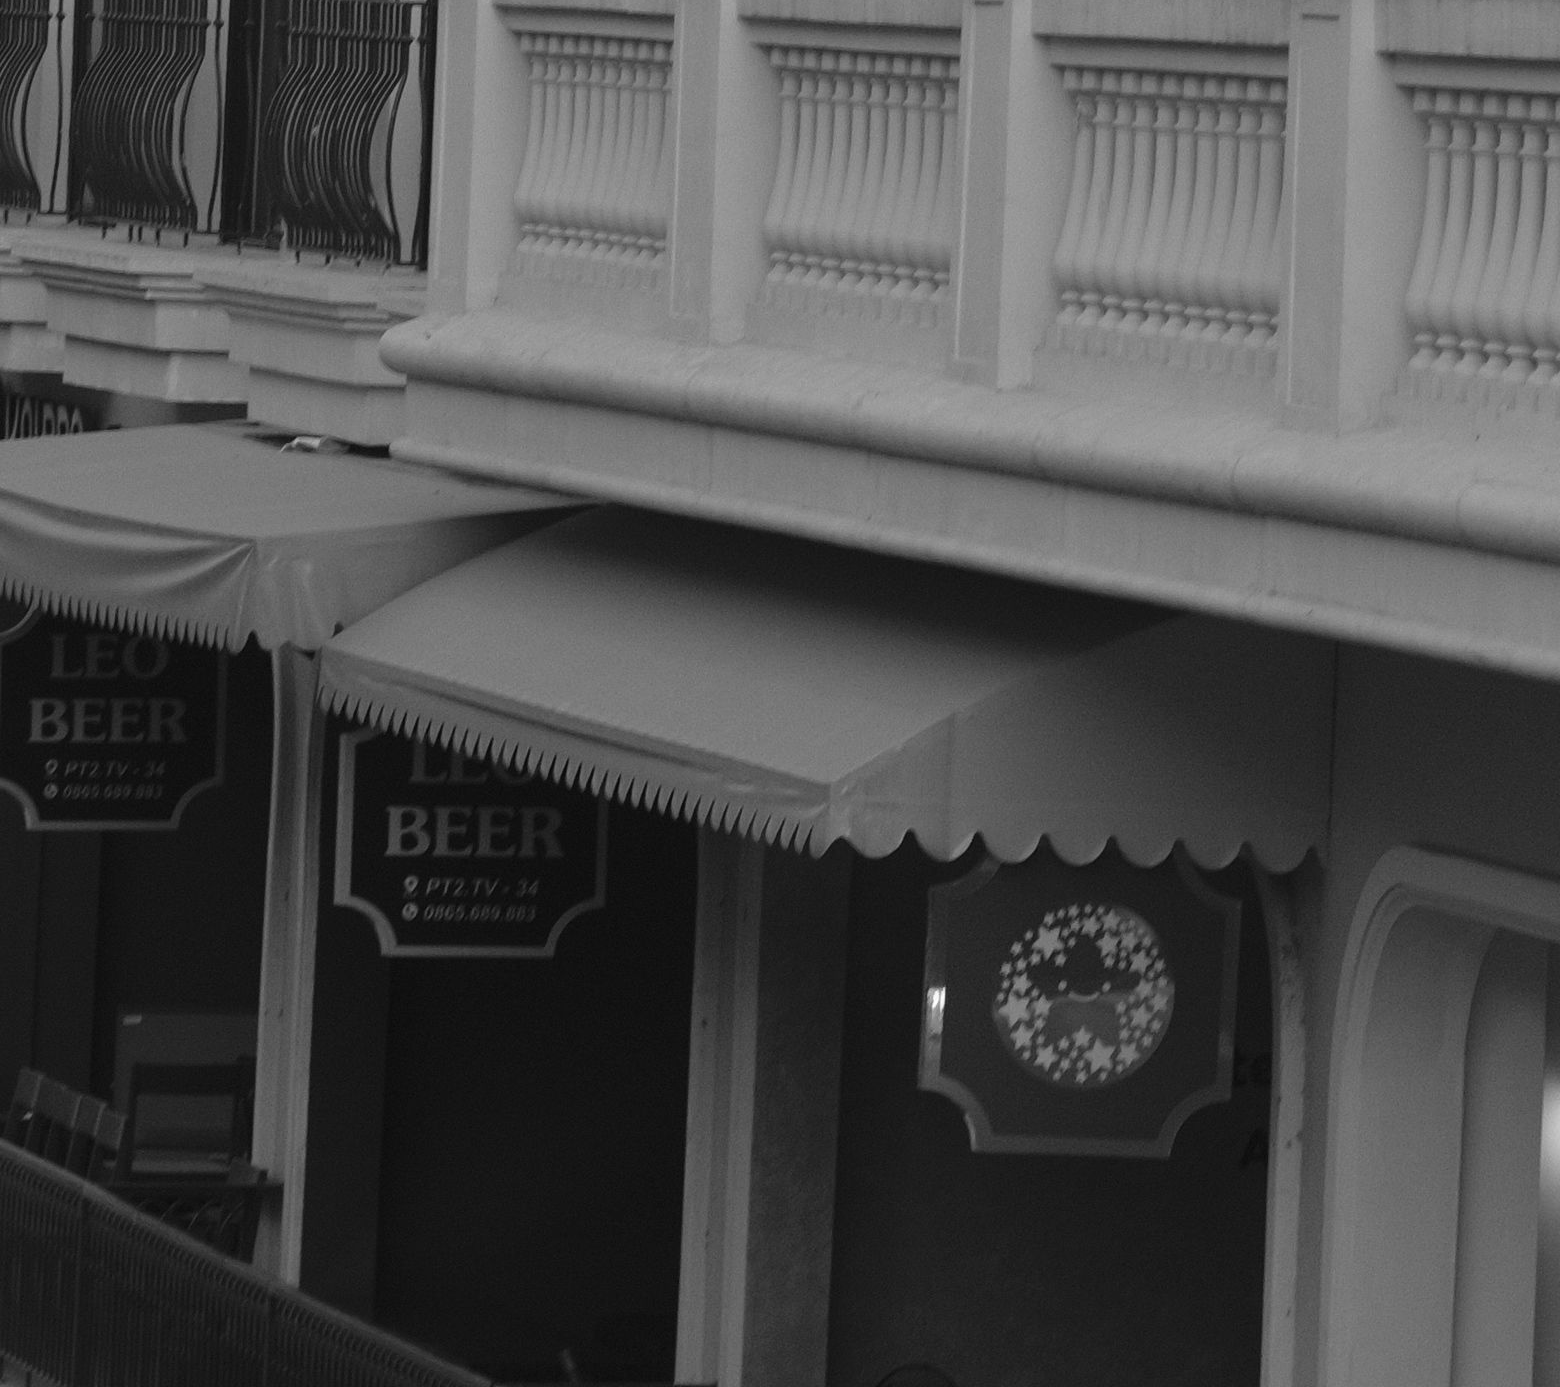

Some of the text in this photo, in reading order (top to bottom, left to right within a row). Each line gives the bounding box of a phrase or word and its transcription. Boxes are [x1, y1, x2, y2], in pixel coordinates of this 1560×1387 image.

[49, 632, 171, 680] LEO
[26, 696, 189, 744] BEER
[383, 804, 565, 859] BEER
